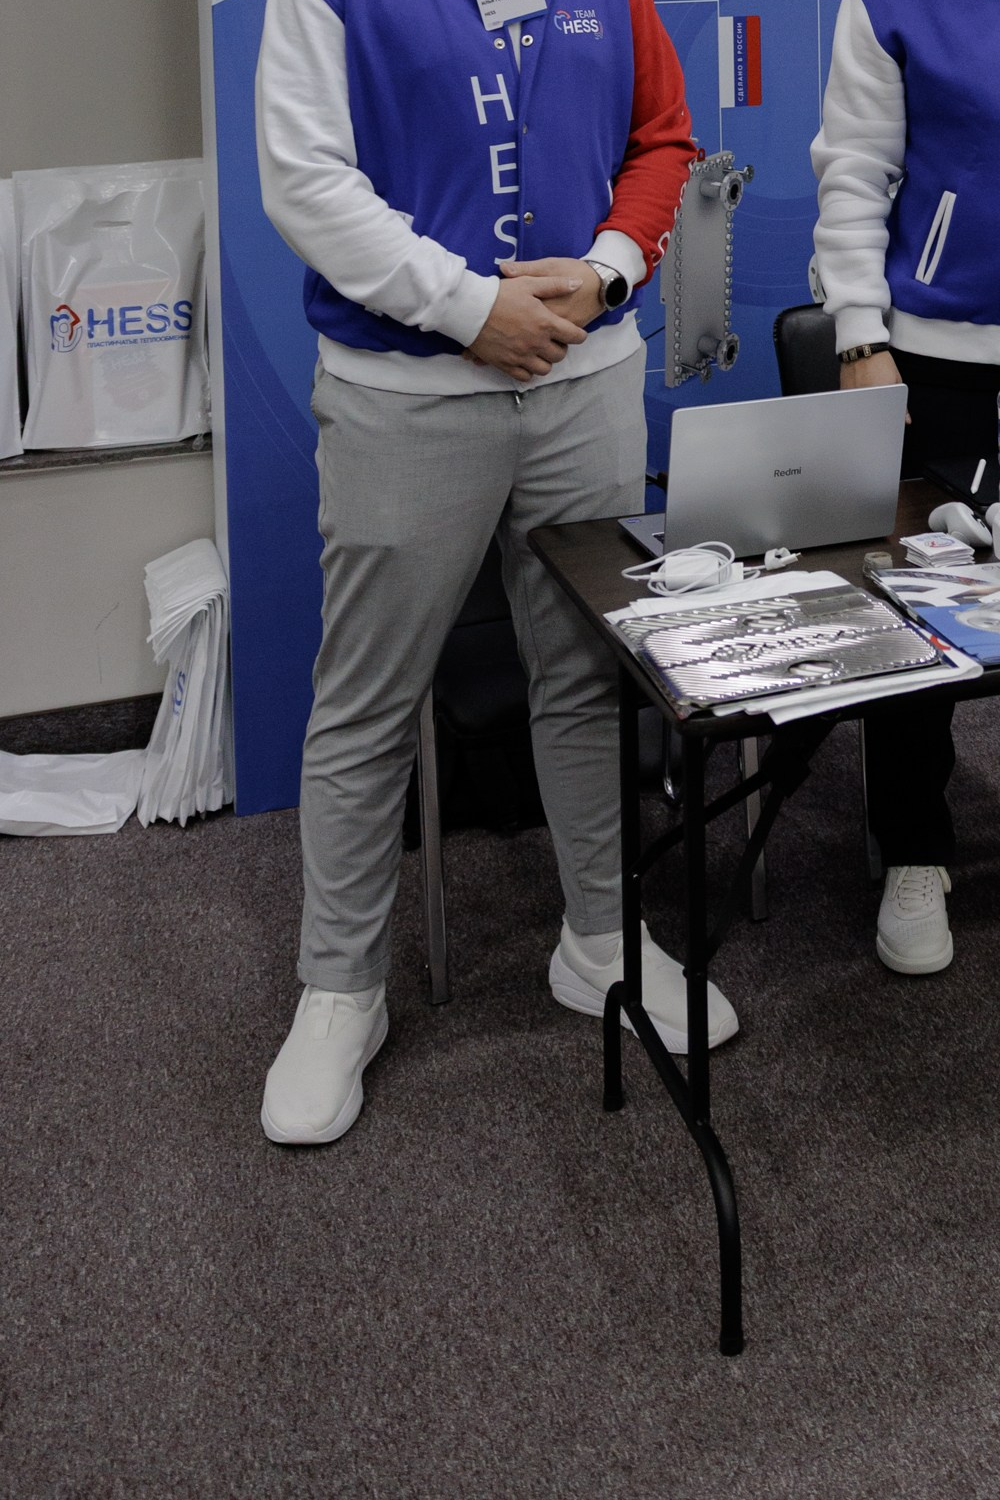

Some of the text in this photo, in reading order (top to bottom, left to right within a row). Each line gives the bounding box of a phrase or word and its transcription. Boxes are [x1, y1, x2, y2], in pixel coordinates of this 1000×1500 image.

[573, 9, 596, 19] TEAM
[562, 19, 599, 35] HESS
[737, 64, 745, 102] СДЕЛАНО
[87, 300, 193, 339] HESS
[87, 338, 138, 349] ПЛАСТИНЧАТЫЕ
[773, 466, 802, 478] Redmi
